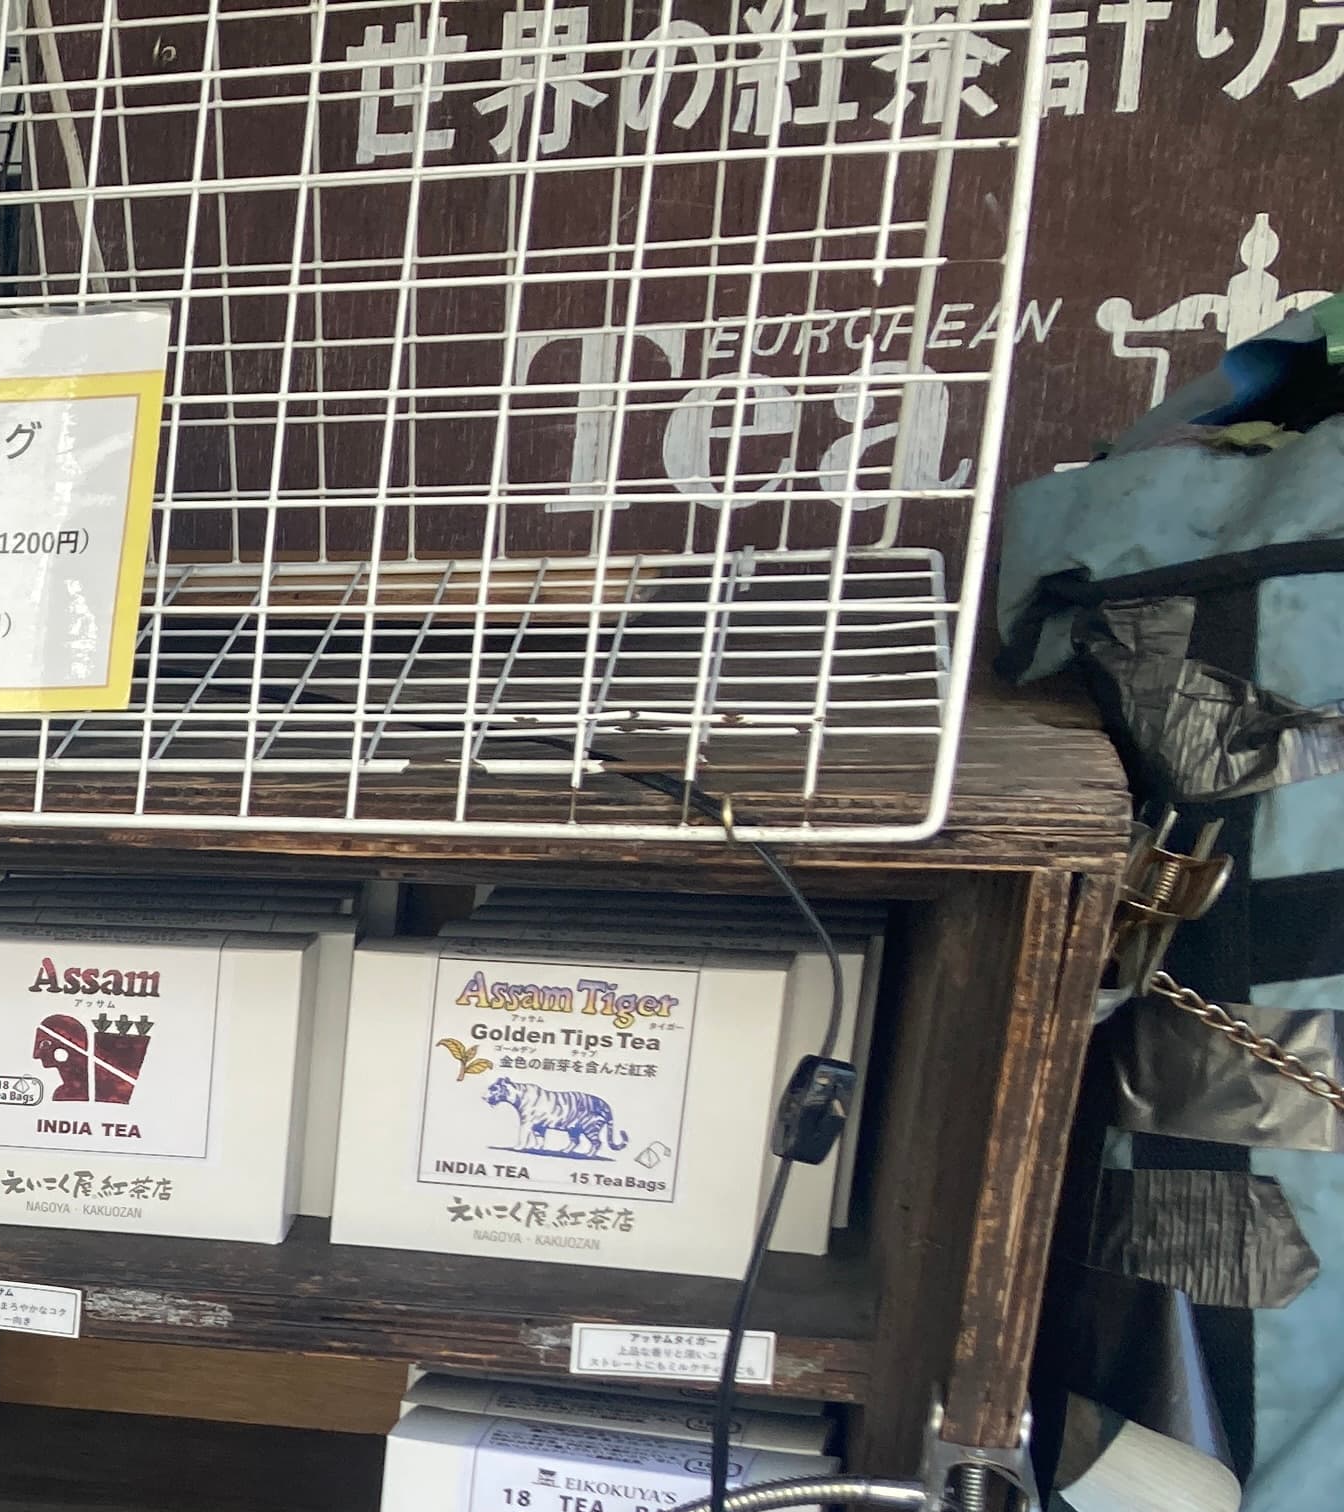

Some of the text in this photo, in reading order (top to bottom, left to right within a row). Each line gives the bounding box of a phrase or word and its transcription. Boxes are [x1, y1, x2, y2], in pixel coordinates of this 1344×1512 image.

[707, 297, 1064, 361] EUROPEAN
[516, 328, 974, 513] Tea
[29, 957, 161, 998] Assam
[73, 998, 116, 1010] アッサム
[456, 971, 679, 1029] Assam Tiger
[470, 1023, 661, 1051] Golden Tips Tea
[570, 1171, 667, 1192] 15 Tea Bags
